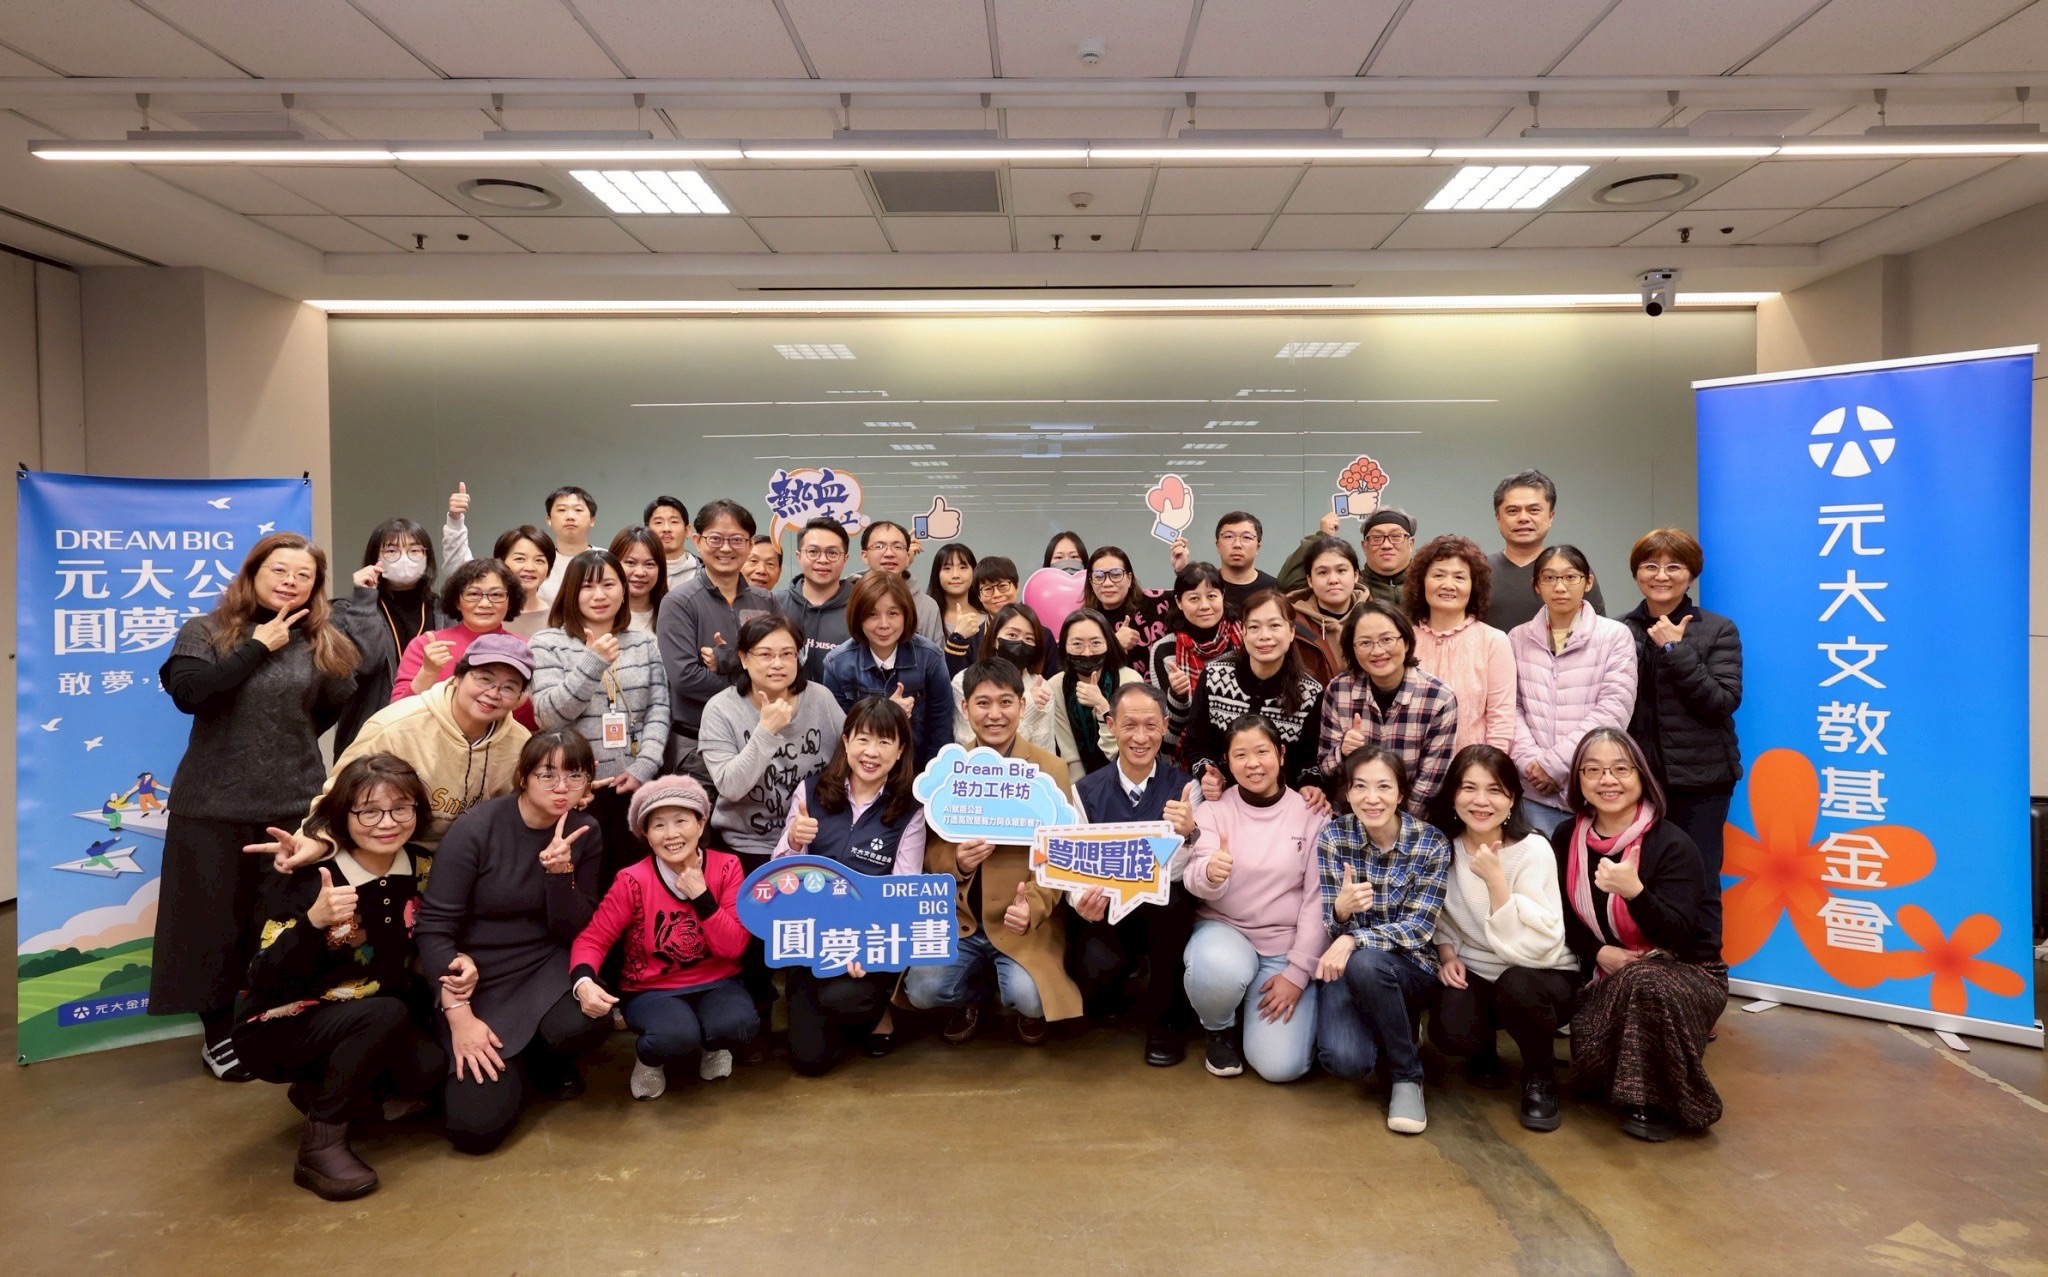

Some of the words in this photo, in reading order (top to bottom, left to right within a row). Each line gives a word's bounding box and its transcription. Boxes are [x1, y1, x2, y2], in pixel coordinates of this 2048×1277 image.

[767, 469, 849, 518] 熱血
[55, 529, 176, 550] DREAM
[183, 531, 234, 550] BIG
[54, 559, 237, 600] 元大公
[54, 606, 208, 655] 圓夢
[58, 670, 166, 696] 敢夢，
[1817, 503, 1893, 954] 元大文教基金會
[953, 760, 1004, 776] Dream
[1009, 763, 1035, 779] Big
[952, 779, 1031, 800] 培力工作坊
[1048, 837, 1155, 880] 夢想實踐
[756, 874, 848, 900] 元大公益
[882, 882, 949, 898] DREAM
[919, 900, 949, 915] BIG
[772, 918, 951, 971] 圓夢計畫
